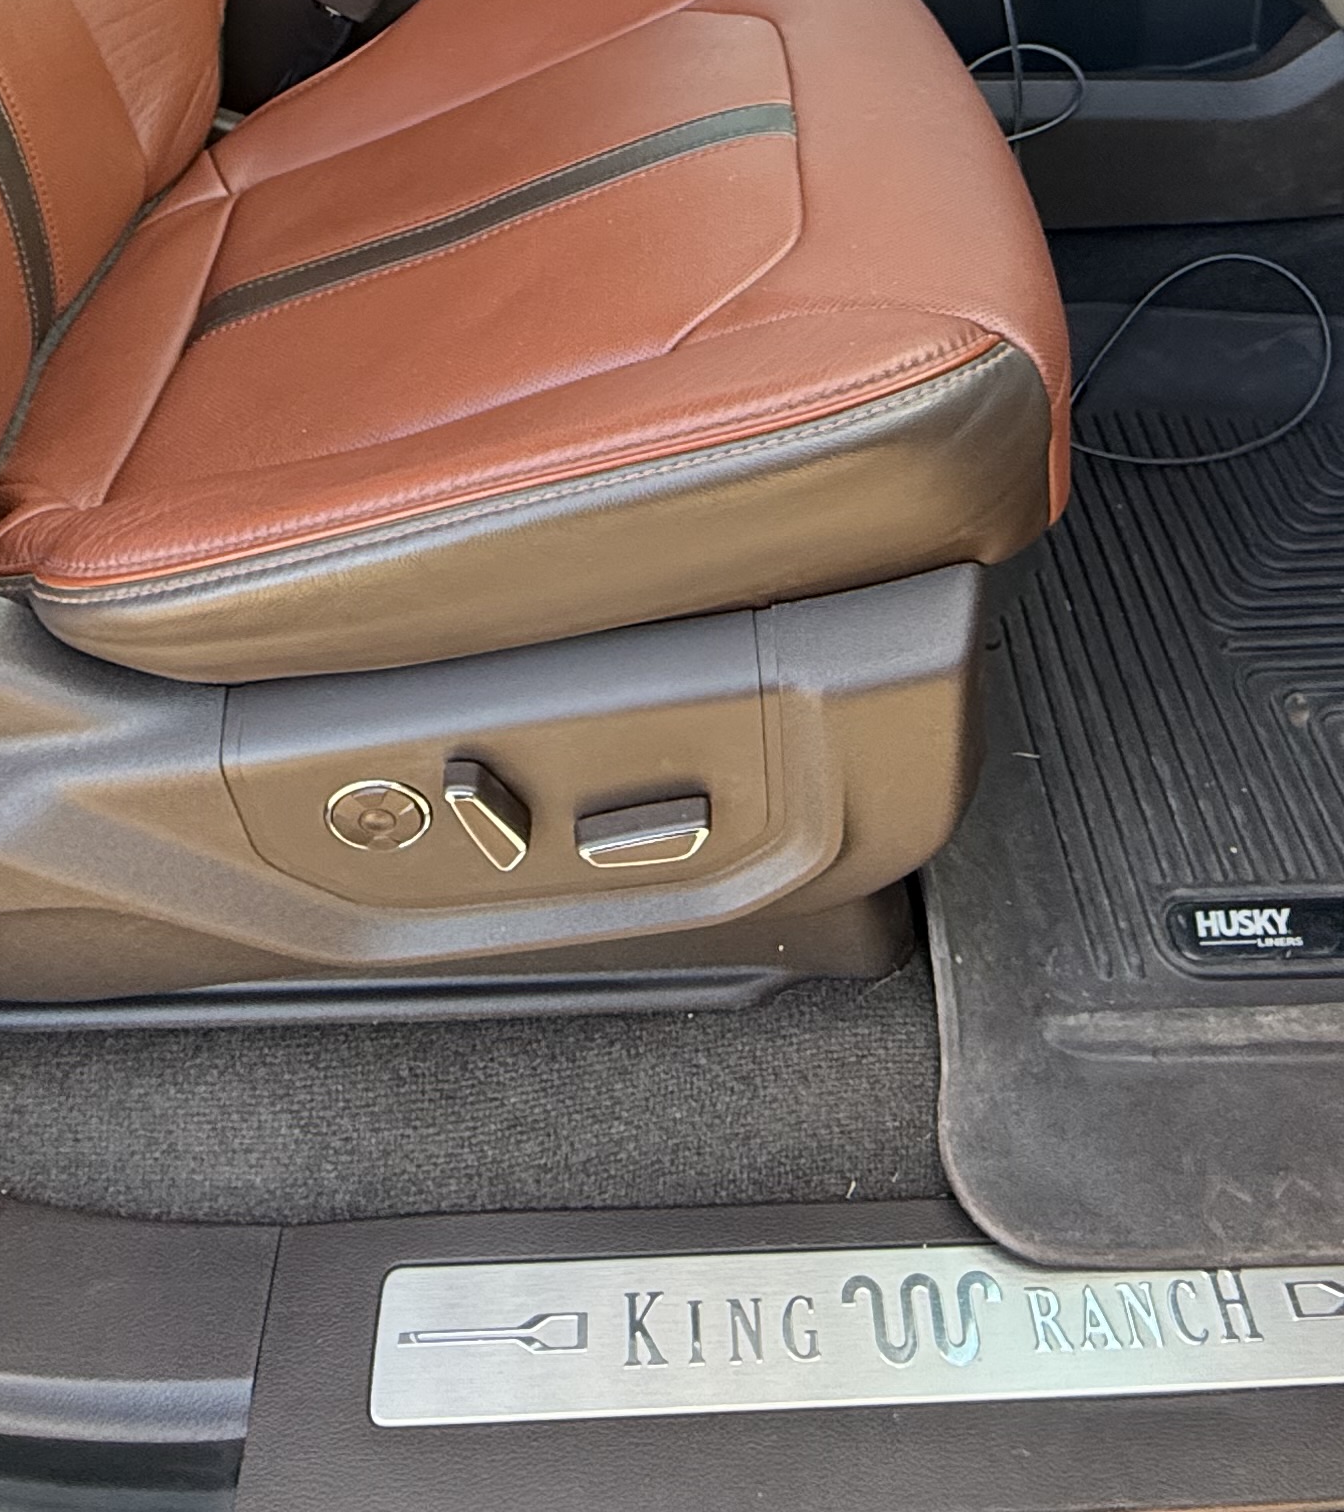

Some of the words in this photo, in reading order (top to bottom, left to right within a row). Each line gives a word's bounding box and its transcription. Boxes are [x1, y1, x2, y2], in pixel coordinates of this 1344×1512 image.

[1195, 908, 1291, 937] HUSKY
[1256, 936, 1304, 947] LINERS
[623, 1291, 822, 1369] KING
[1024, 1269, 1265, 1352] RANCH
